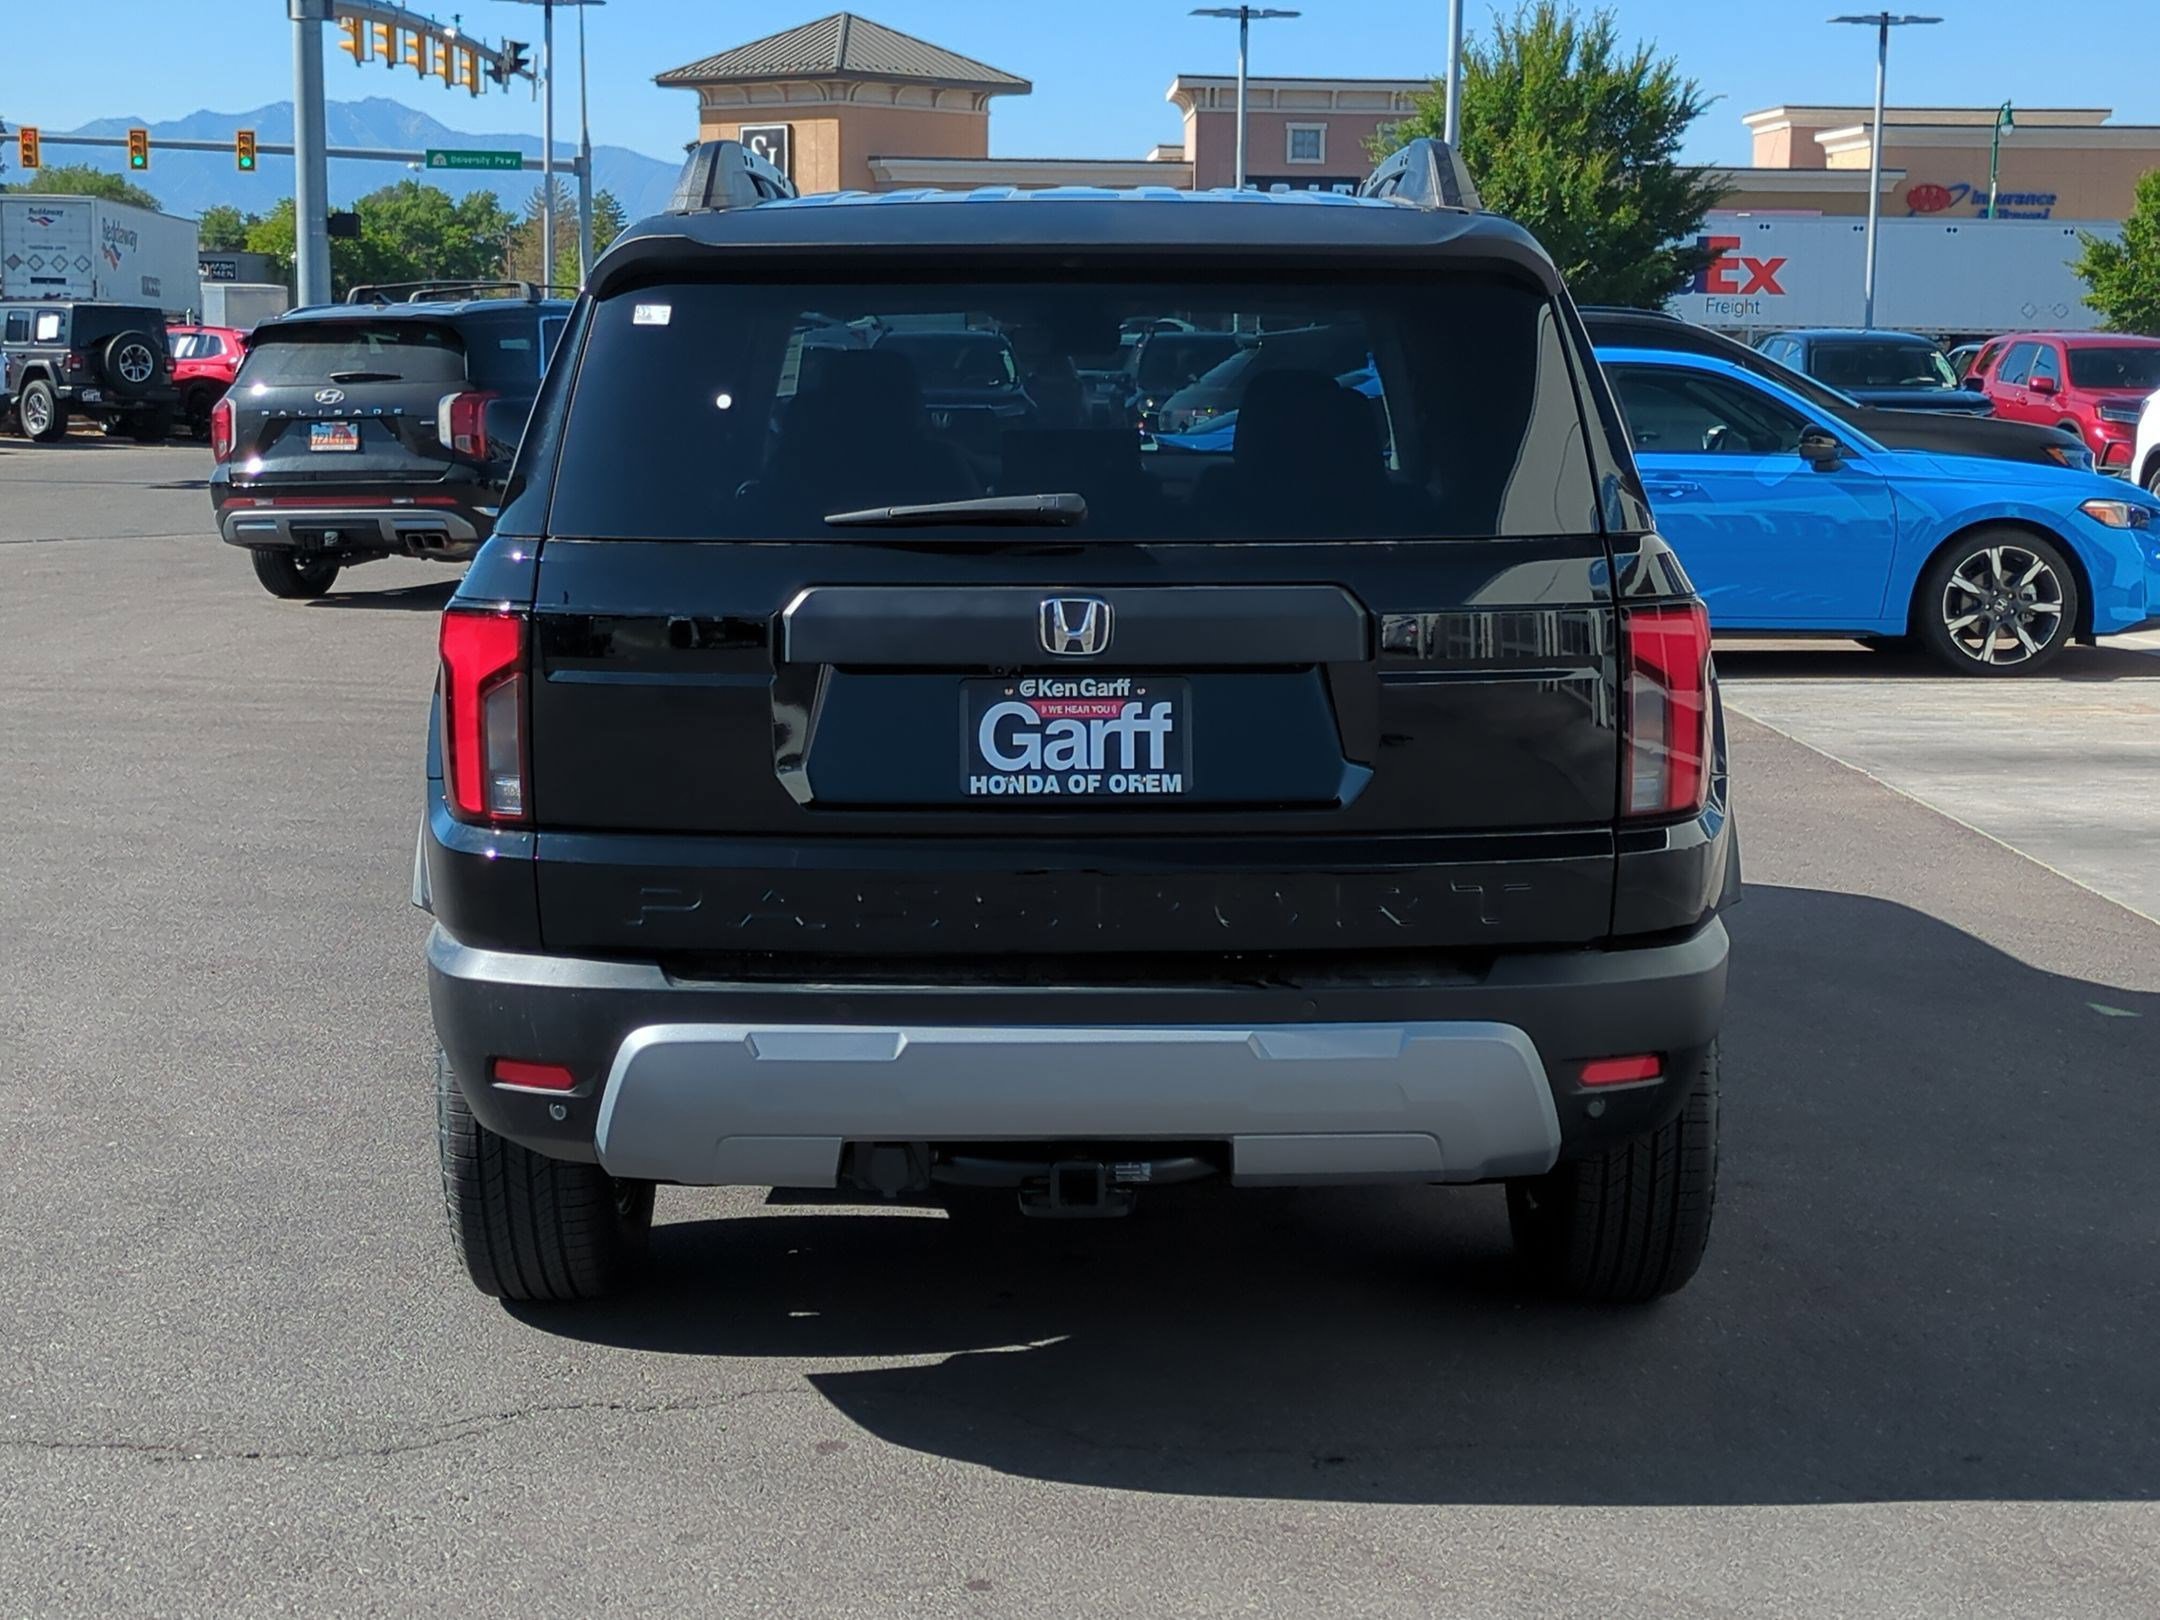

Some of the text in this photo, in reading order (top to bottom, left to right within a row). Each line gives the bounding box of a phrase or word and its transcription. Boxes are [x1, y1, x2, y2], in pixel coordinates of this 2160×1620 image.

[450, 155, 517, 166] University Pkwy
[1971, 190, 2057, 206] Inurance
[102, 217, 138, 253] Reddaway
[1705, 297, 1761, 318] Freight
[261, 408, 404, 417] PALISADE
[1038, 678, 1131, 697] Ken Garff
[1049, 705, 1111, 714] WE HEAR YOU
[979, 701, 1173, 772] Garff
[970, 774, 1183, 795] HONDA OF OREM
